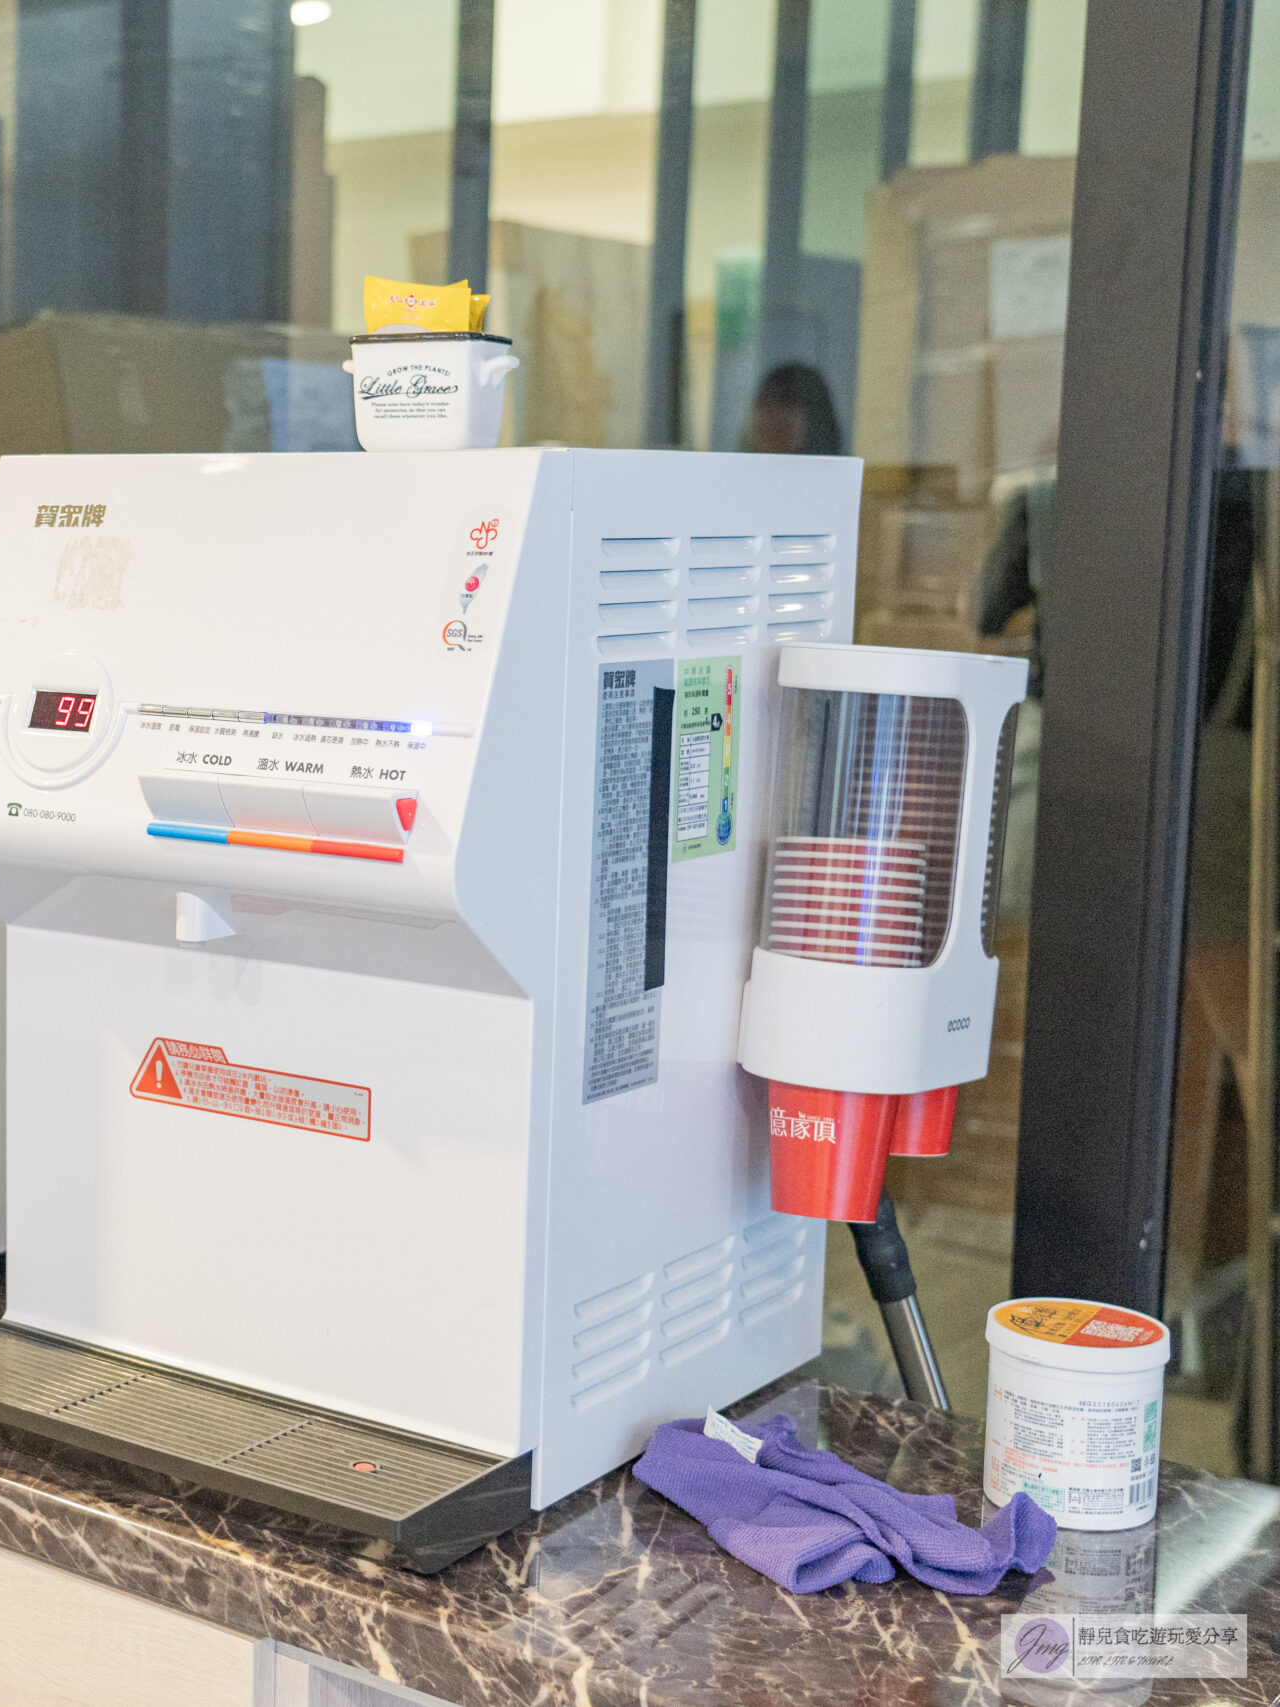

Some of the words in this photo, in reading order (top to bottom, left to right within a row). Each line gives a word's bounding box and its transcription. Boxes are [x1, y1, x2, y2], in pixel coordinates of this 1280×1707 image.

[387, 365, 408, 376] GROW
[357, 375, 403, 400] Little
[447, 628, 463, 638] SGS
[55, 696, 96, 728] 99
[176, 751, 198, 764] 冰水
[202, 754, 232, 766] COLD
[257, 758, 280, 771] 溫水
[285, 761, 324, 774] WARM
[349, 765, 374, 779] 熱水
[379, 768, 406, 781] HOT
[23, 808, 77, 822] 080-080-9000
[947, 1016, 970, 1033] ecoco
